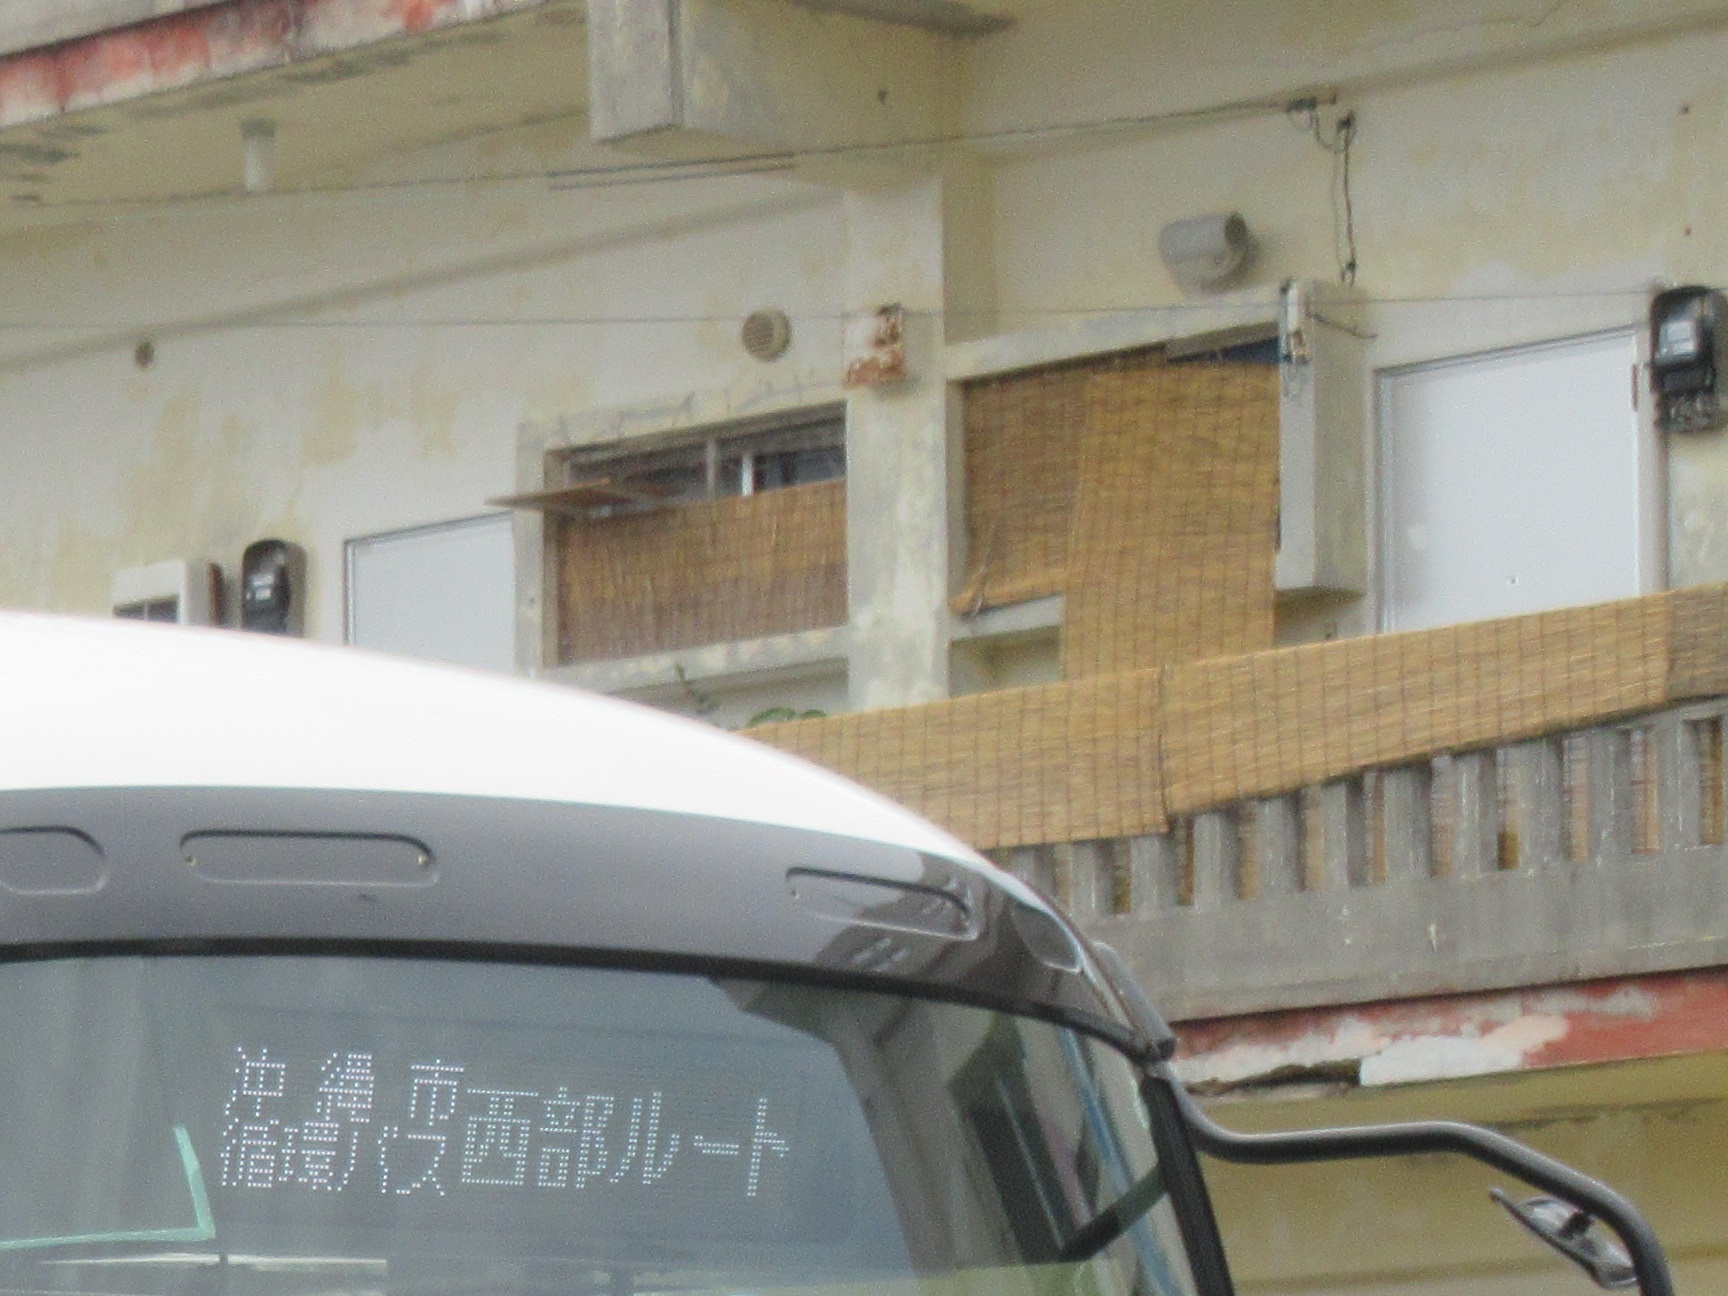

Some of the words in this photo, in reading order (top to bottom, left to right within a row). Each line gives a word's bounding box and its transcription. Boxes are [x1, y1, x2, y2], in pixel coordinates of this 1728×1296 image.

[461, 1086, 790, 1196] 西部ルート
